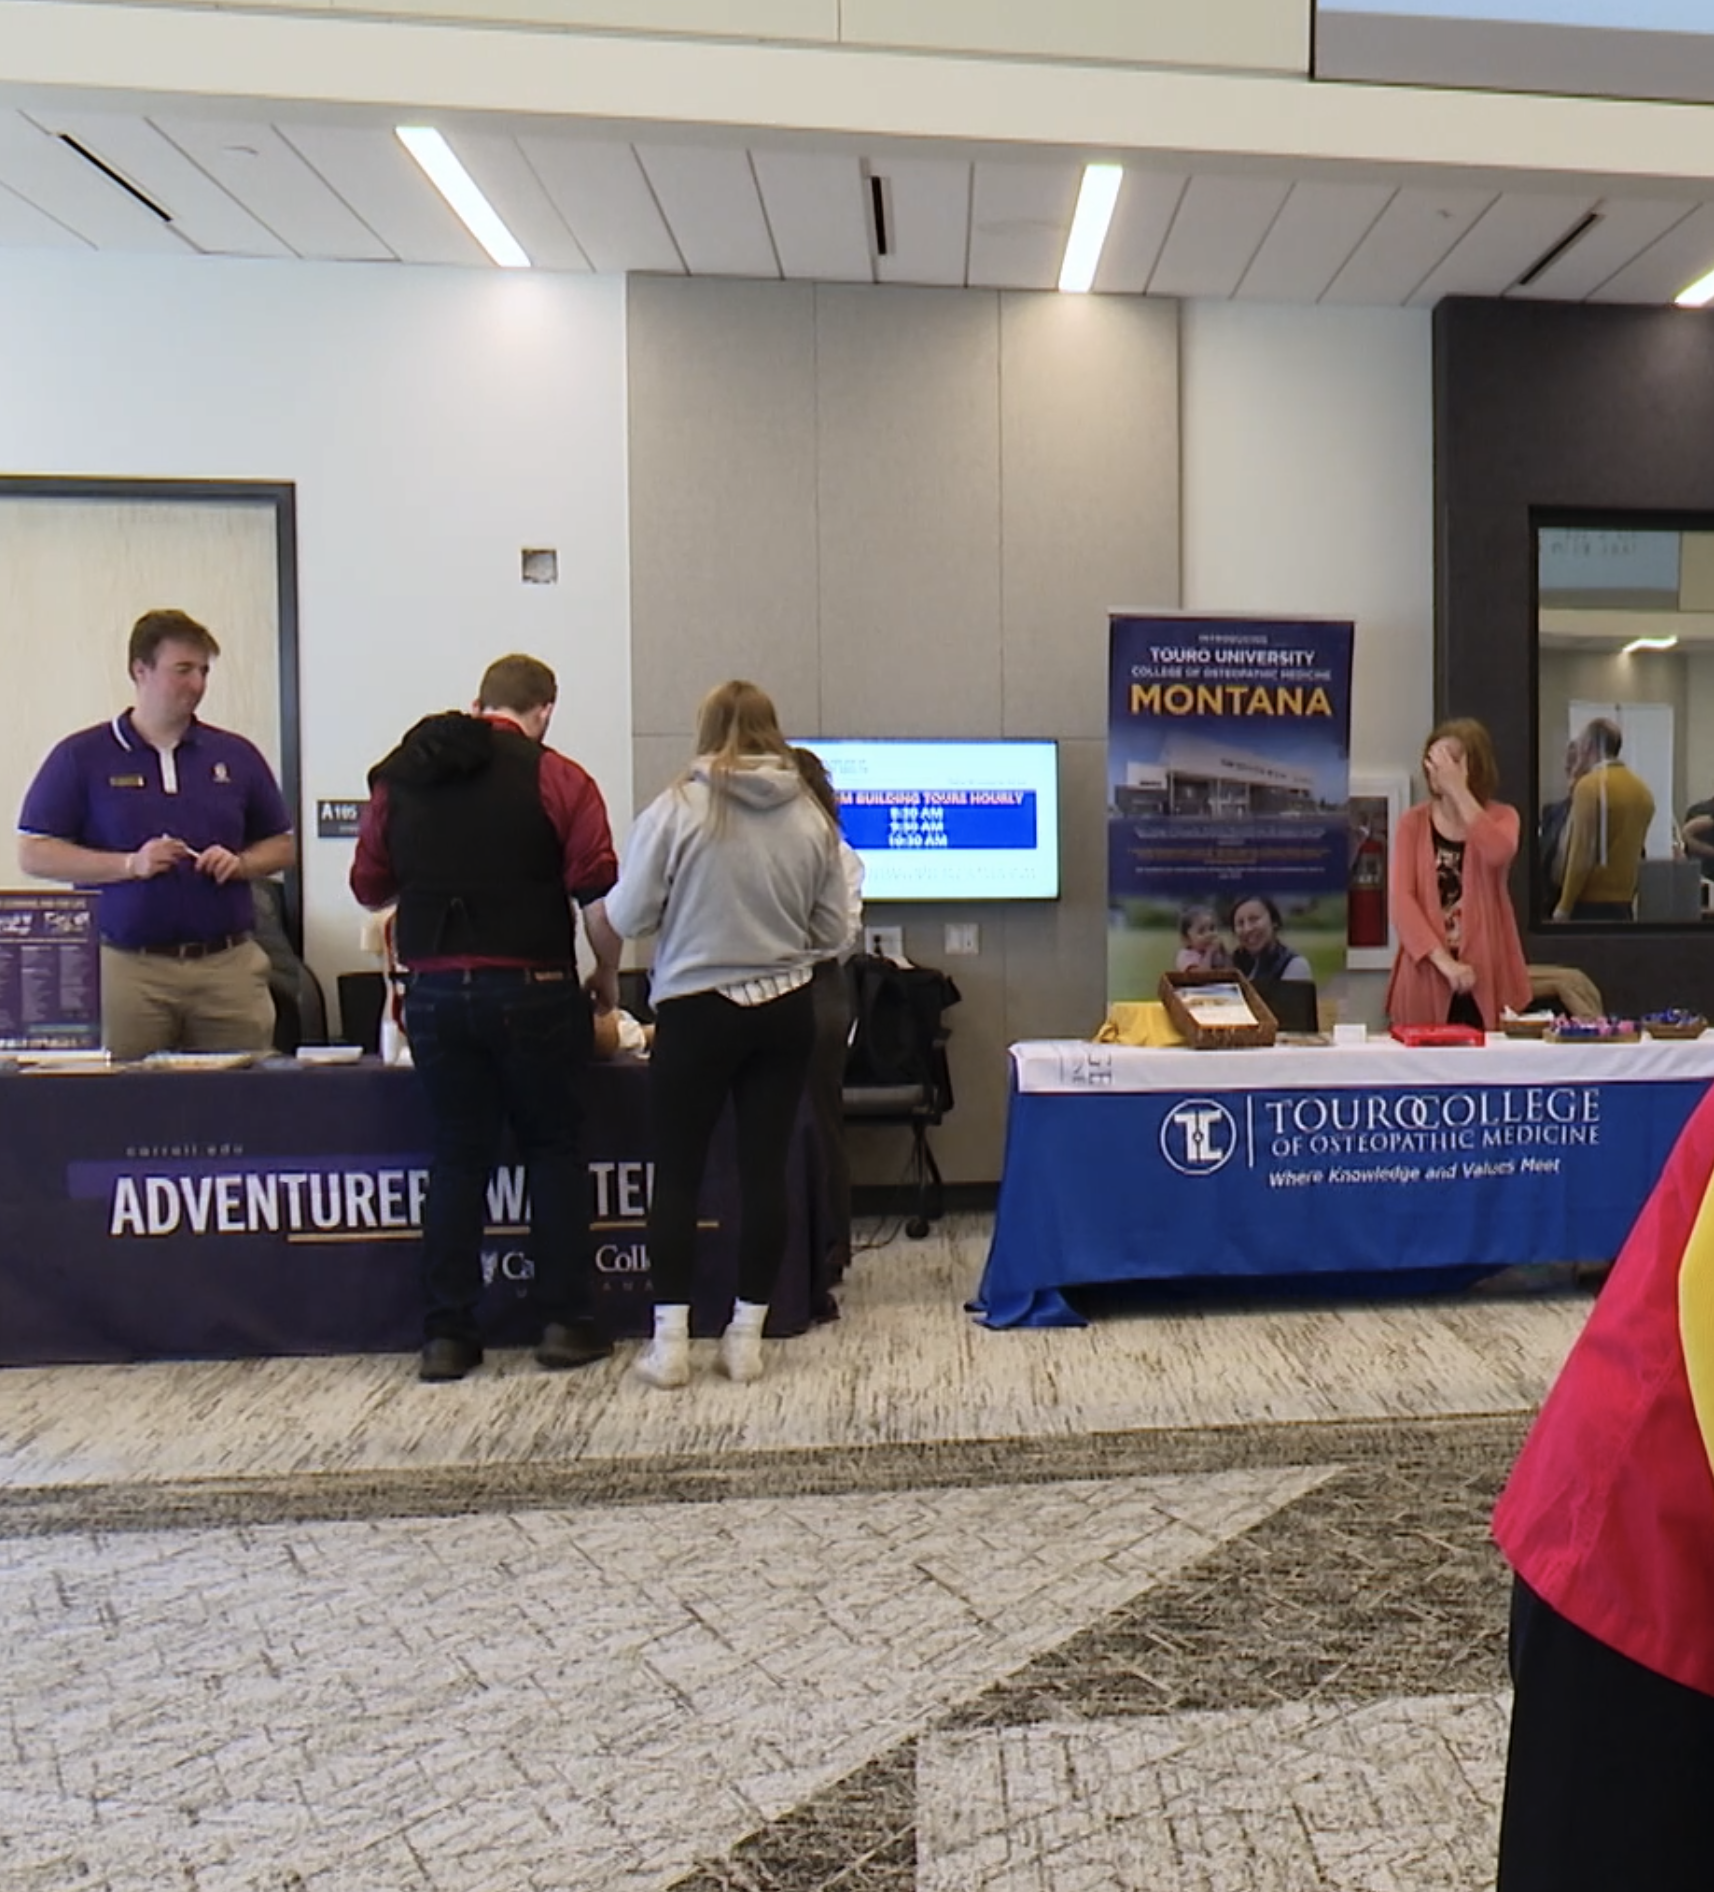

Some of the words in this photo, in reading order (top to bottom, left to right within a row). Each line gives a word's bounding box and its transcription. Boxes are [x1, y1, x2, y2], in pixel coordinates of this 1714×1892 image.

[1131, 664, 1182, 679] COLLEGE
[1185, 667, 1201, 679] OF
[1203, 668, 1278, 681] OSTEOPATHIC
[1150, 647, 1212, 665] TOURO
[1215, 649, 1316, 667] UNIVERSITY
[1130, 683, 1334, 717] MONTANA
[1265, 1095, 1427, 1135] TOURO
[1412, 1086, 1601, 1131] COLLEGE
[1271, 1136, 1304, 1158] OF
[1309, 1129, 1475, 1154] OSTEOPATHIC
[1481, 1124, 1600, 1148] MEDICINE
[1269, 1171, 1324, 1188] Where
[1328, 1164, 1421, 1184] Knowledge
[1424, 1162, 1459, 1180] and
[1462, 1159, 1516, 1180] Values
[1519, 1156, 1561, 1175] Meet
